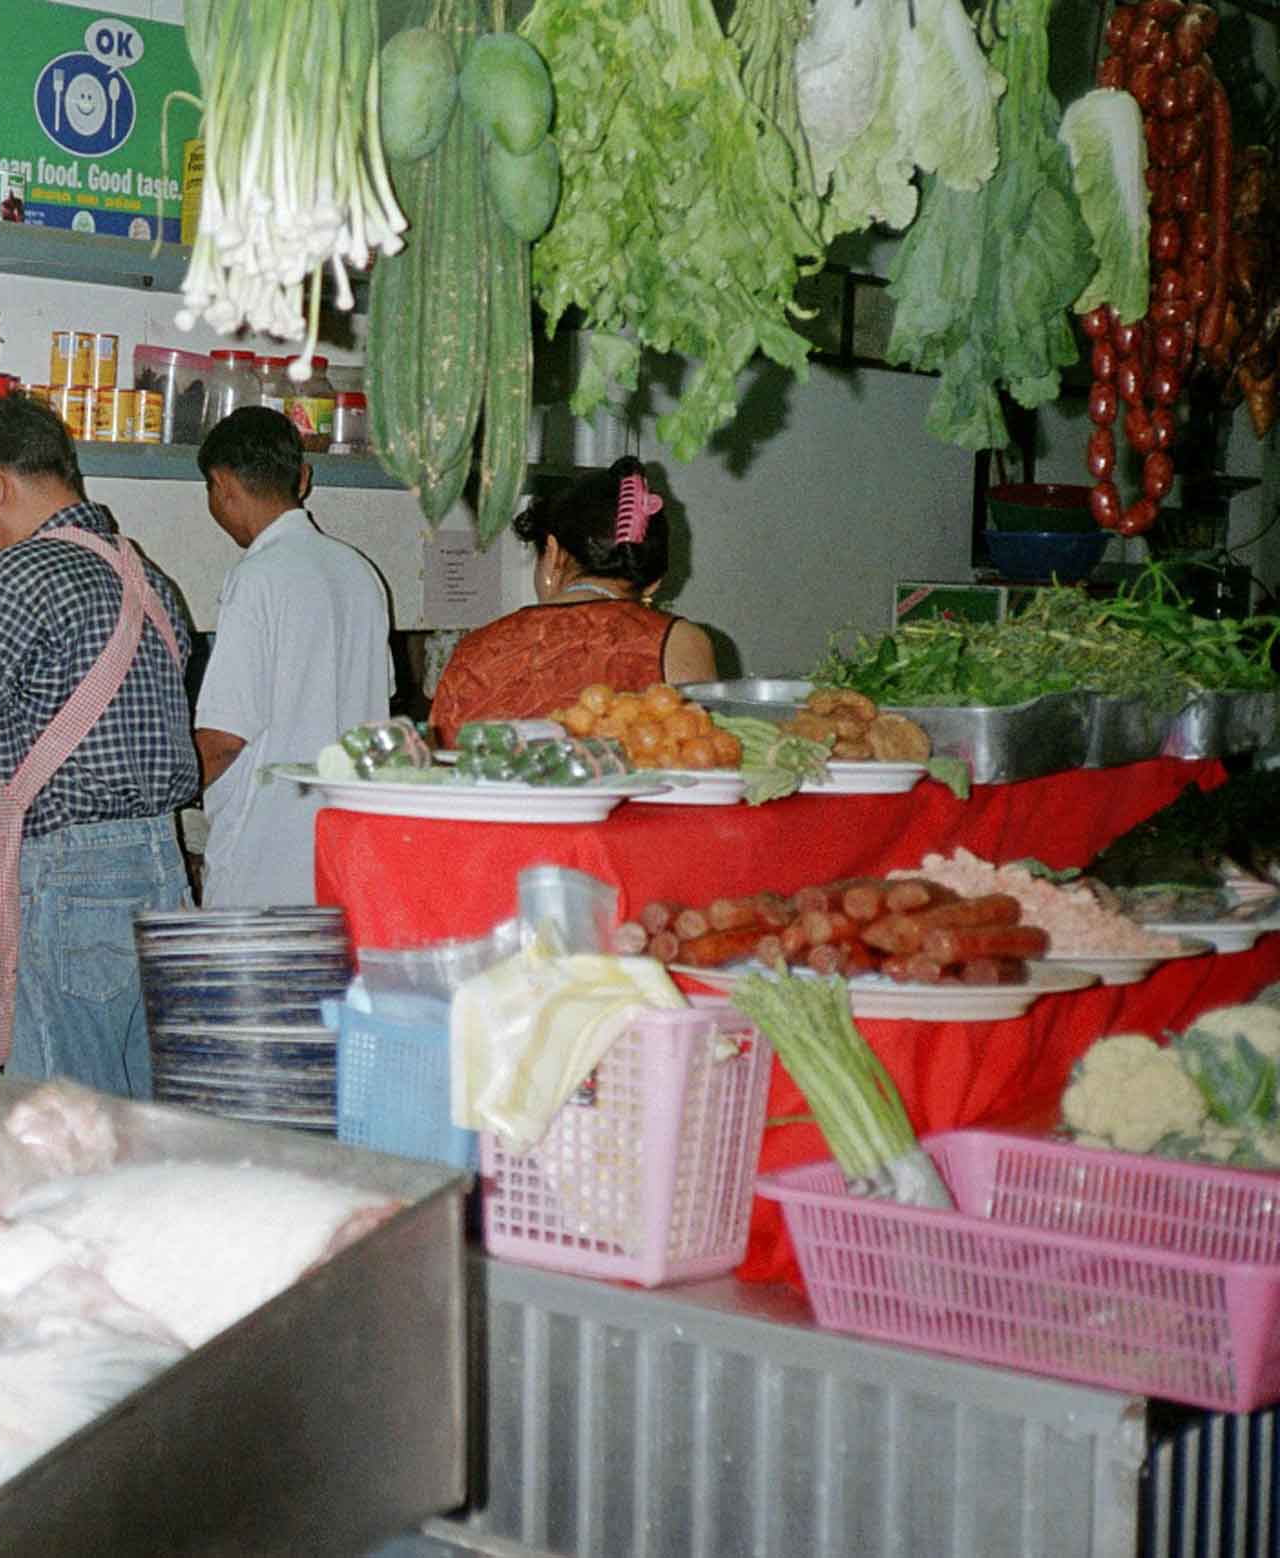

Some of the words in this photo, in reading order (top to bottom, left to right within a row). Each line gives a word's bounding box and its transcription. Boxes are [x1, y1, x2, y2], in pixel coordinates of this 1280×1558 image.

[96, 28, 133, 59] OK
[37, 156, 82, 188] food.
[87, 163, 131, 194] Good
[137, 173, 183, 200] taste.
